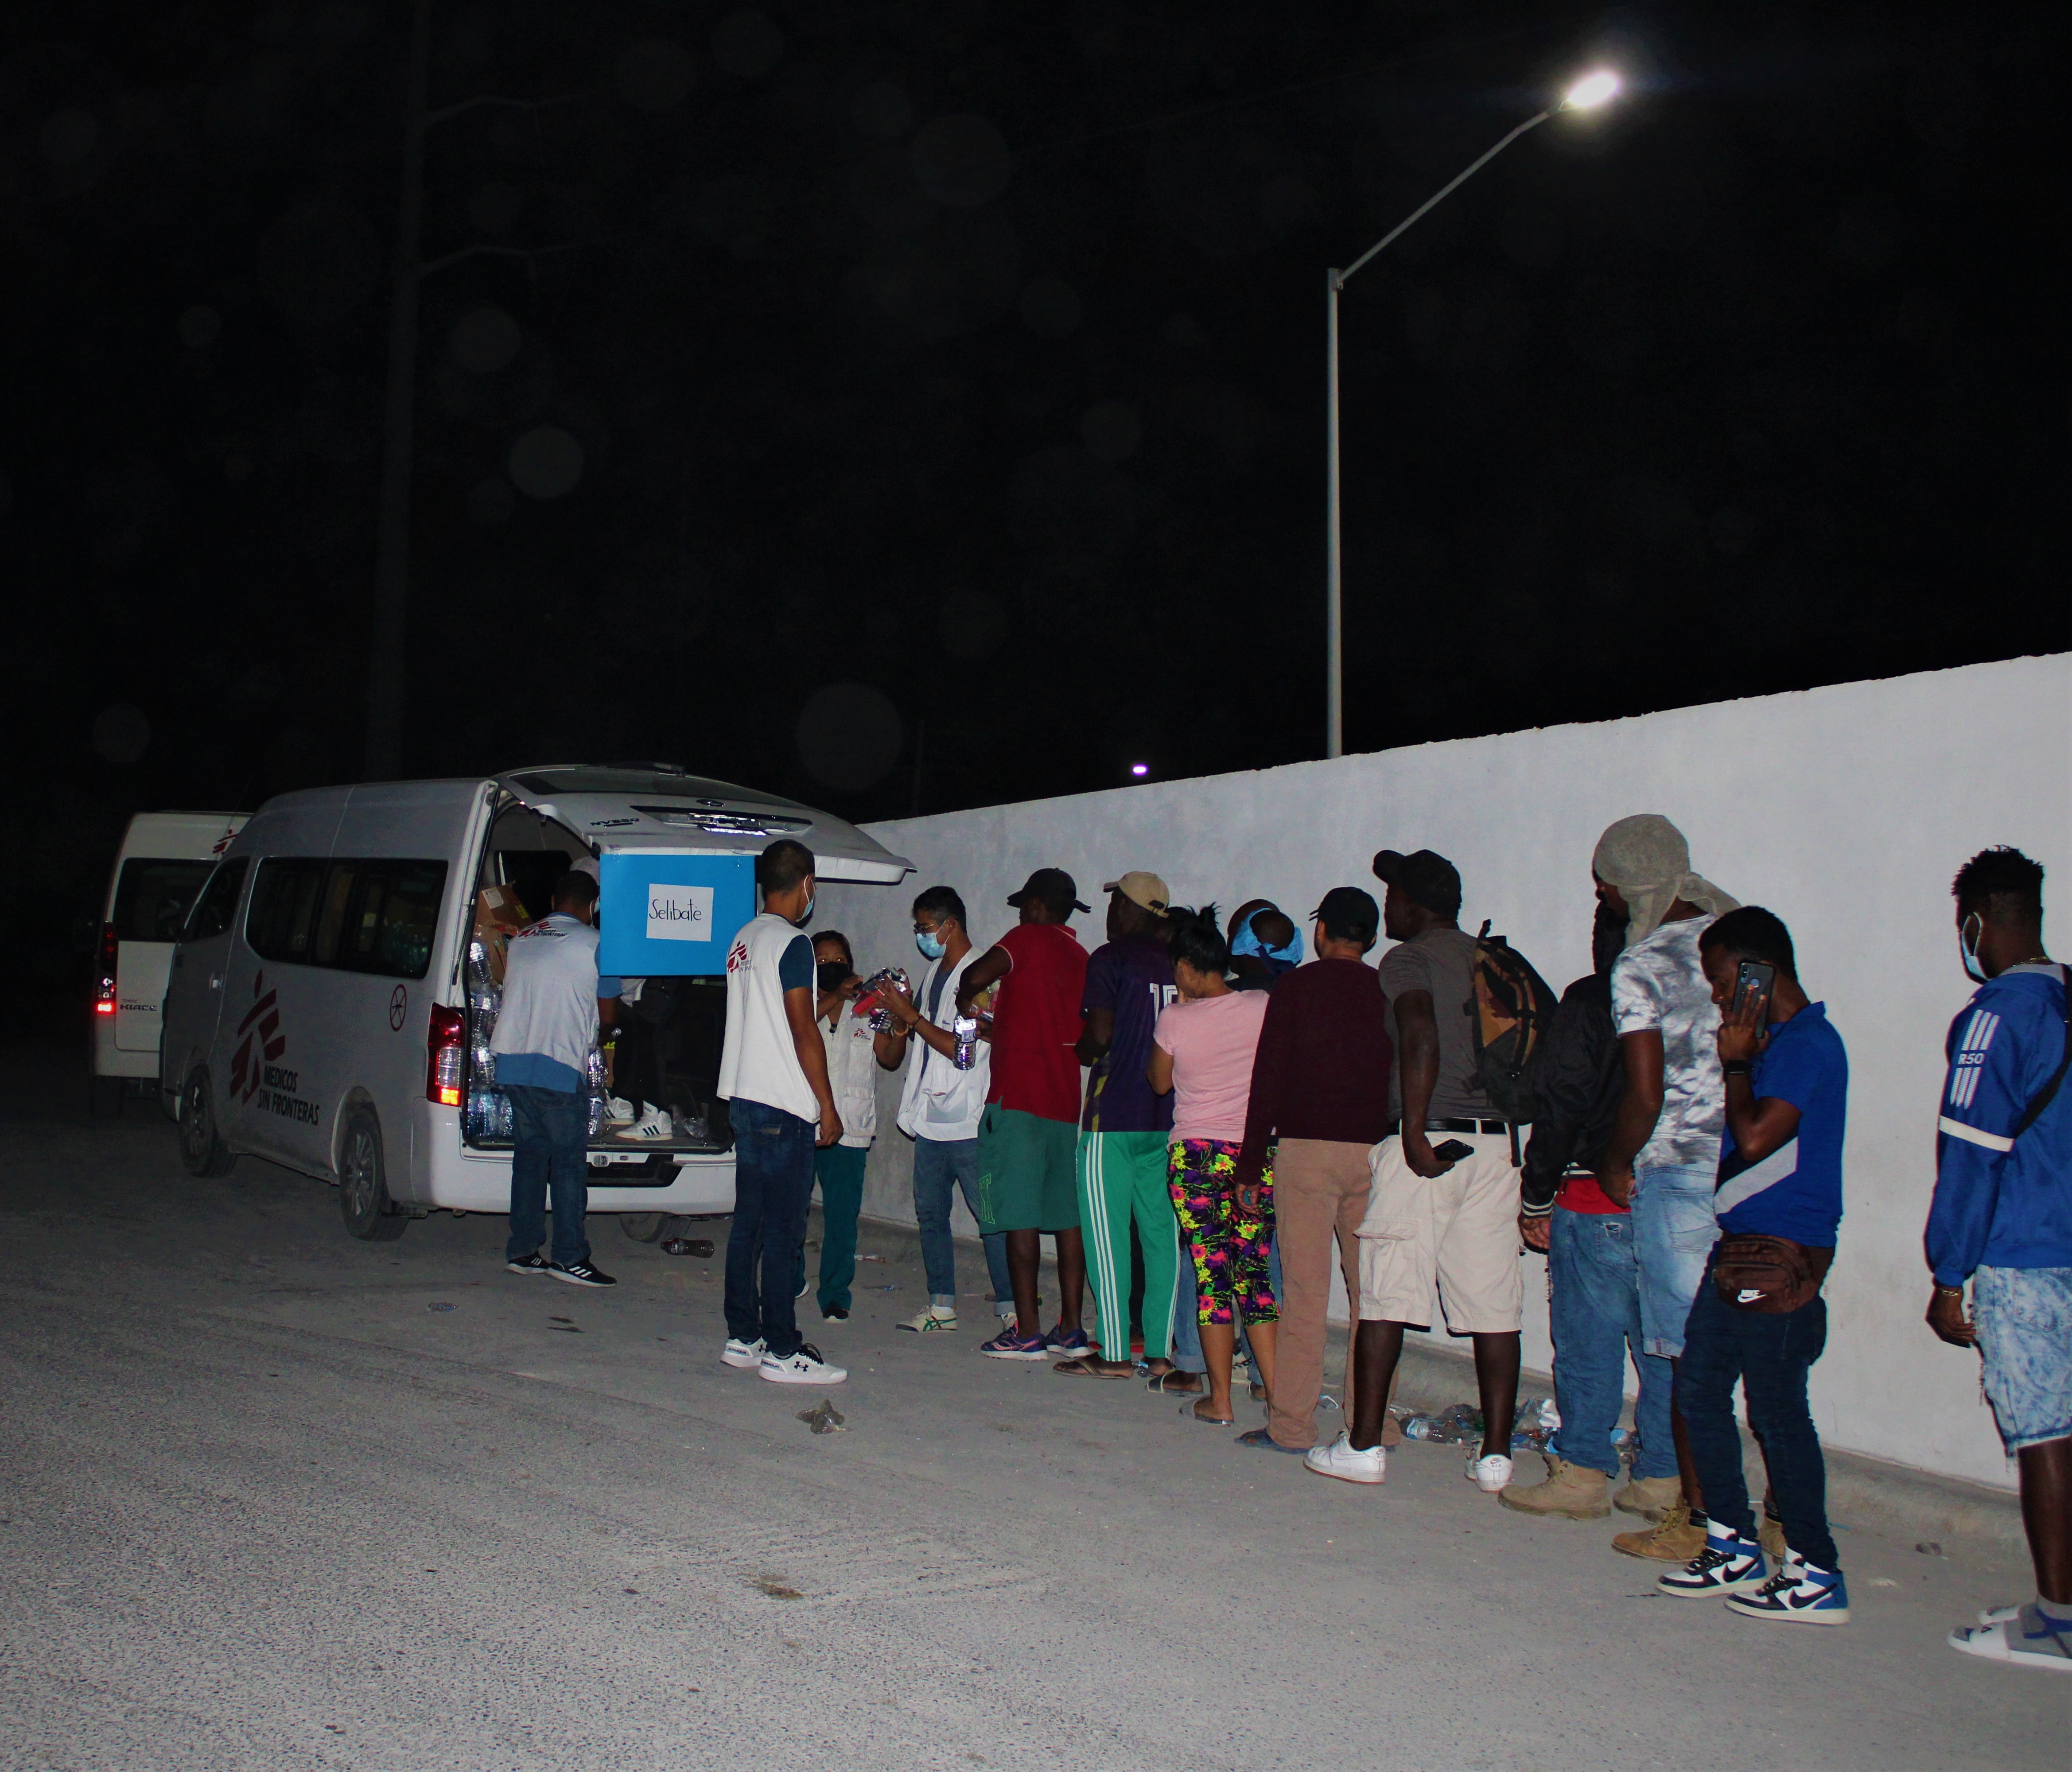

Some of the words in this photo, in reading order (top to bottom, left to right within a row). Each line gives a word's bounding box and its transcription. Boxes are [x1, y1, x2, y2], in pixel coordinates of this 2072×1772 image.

[1958, 1053, 1985, 1065] R50
[264, 1065, 299, 1093] MEDICOS
[257, 1088, 271, 1111] SIN
[272, 1092, 320, 1126] FRONTERAS
[1741, 1289, 1761, 1298] NIKE
